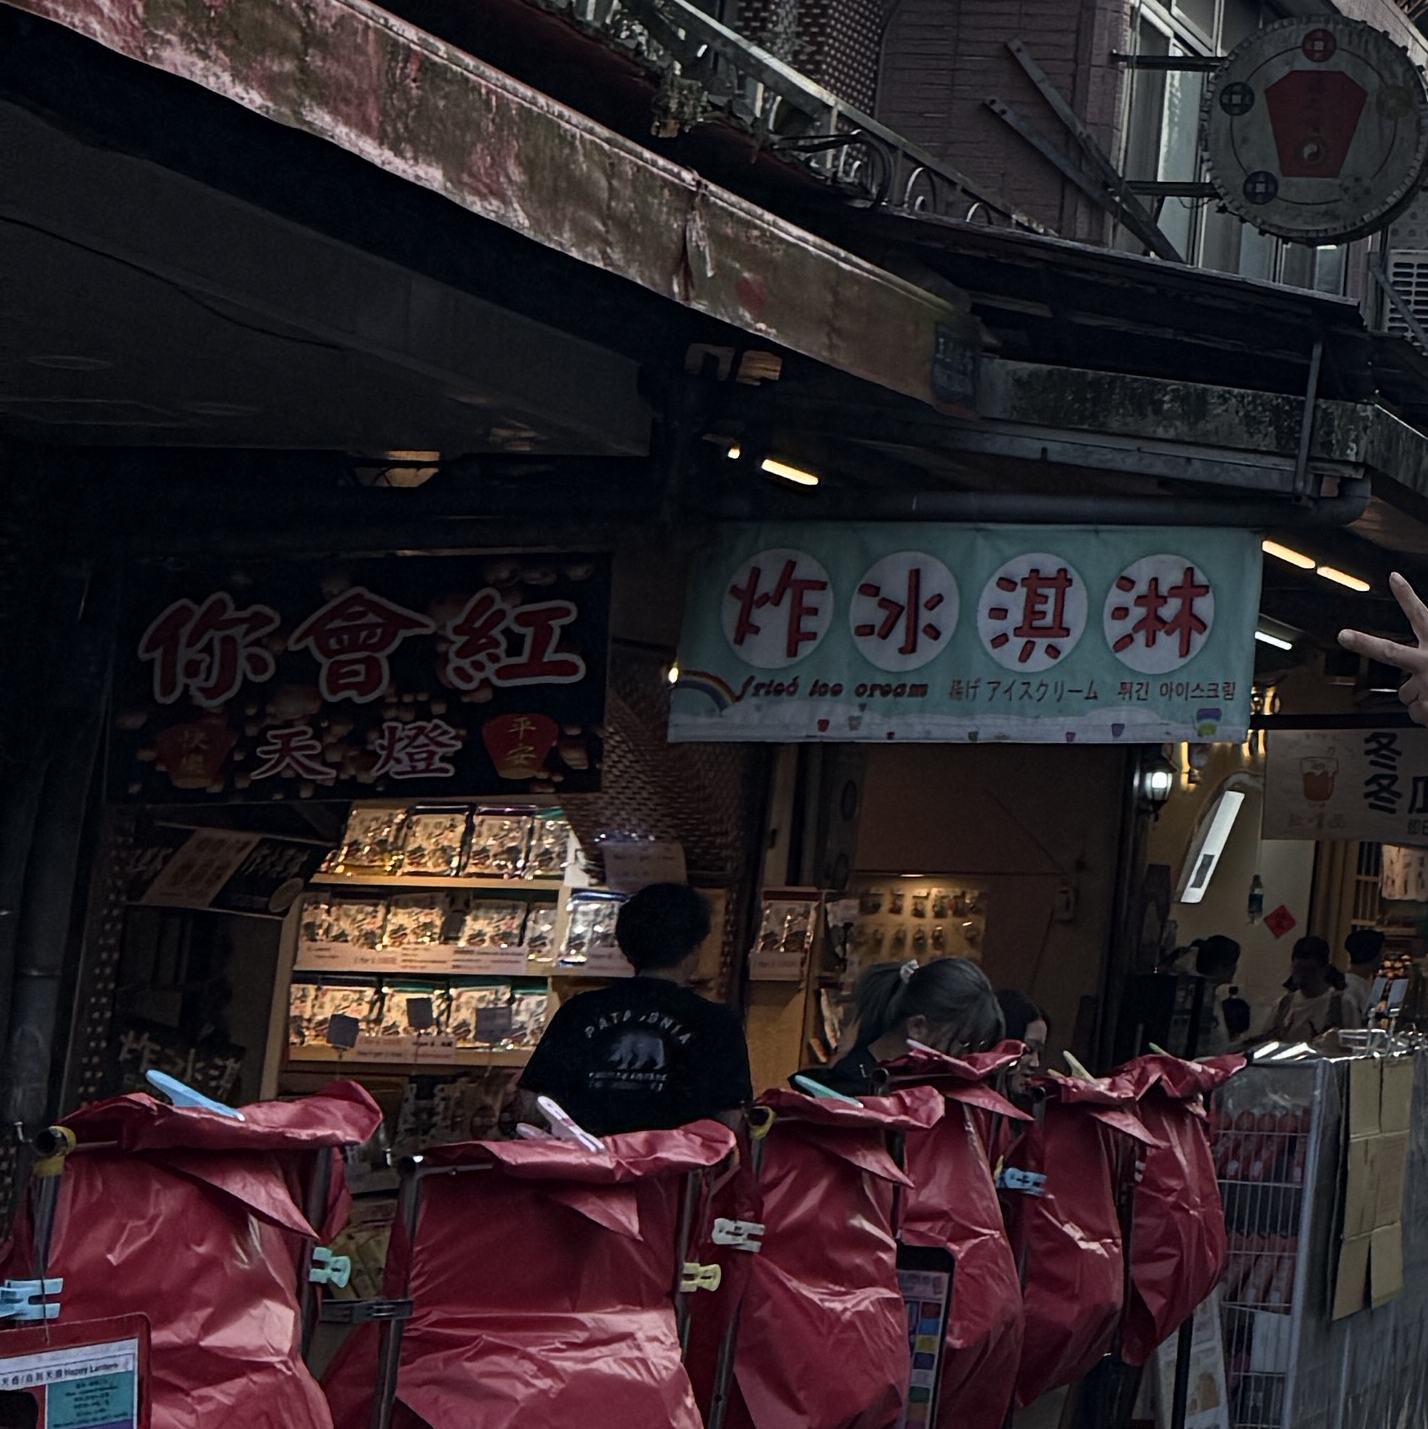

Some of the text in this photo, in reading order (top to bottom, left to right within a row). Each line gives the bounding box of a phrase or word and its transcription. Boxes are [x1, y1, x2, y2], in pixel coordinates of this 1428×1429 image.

[729, 558, 1210, 662] 炸冰淇淋
[138, 586, 587, 706] 你會紅
[734, 674, 800, 704] fried
[854, 682, 930, 699] cream
[1159, 679, 1237, 703] 아이스크림
[250, 718, 464, 781] 天燈
